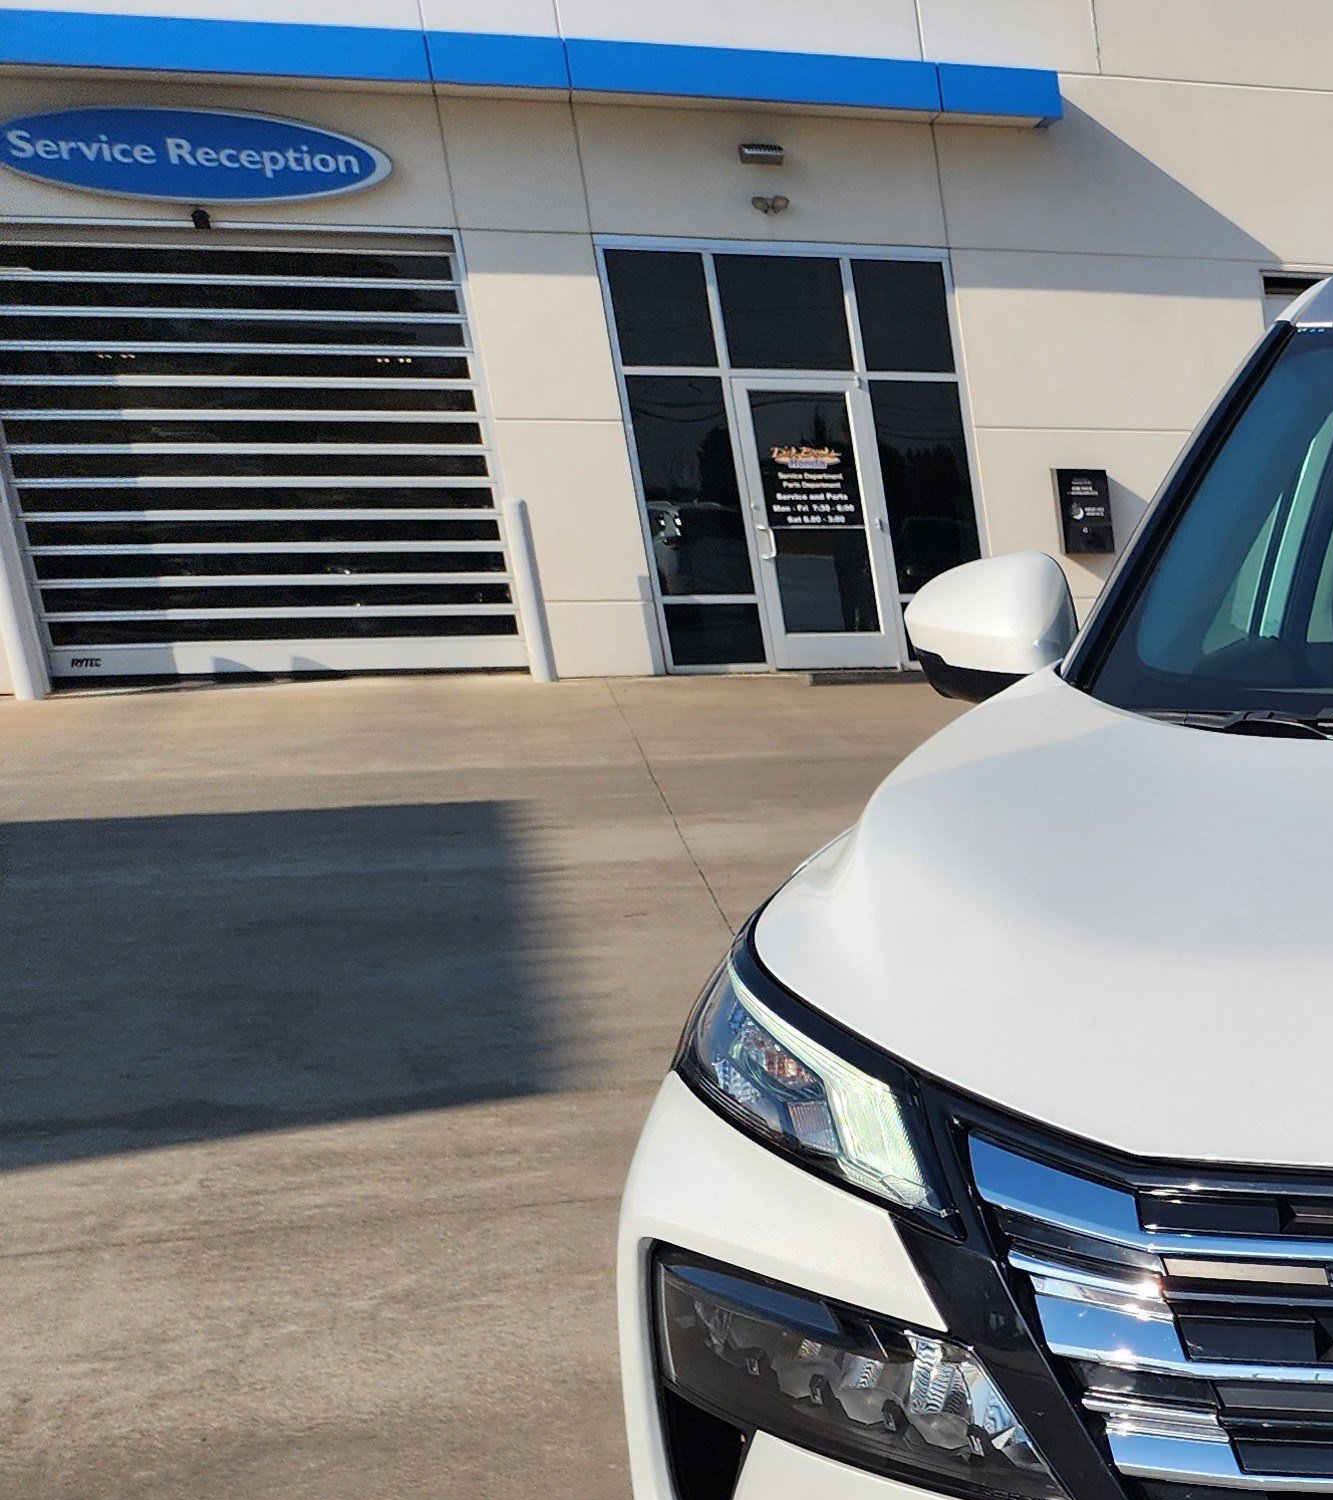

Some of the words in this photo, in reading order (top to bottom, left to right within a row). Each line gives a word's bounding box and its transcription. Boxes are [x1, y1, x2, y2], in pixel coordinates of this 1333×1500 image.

[6, 129, 157, 165] Service
[166, 137, 361, 178] Reception
[776, 492, 808, 501] Service
[71, 658, 102, 668] RYTEC
